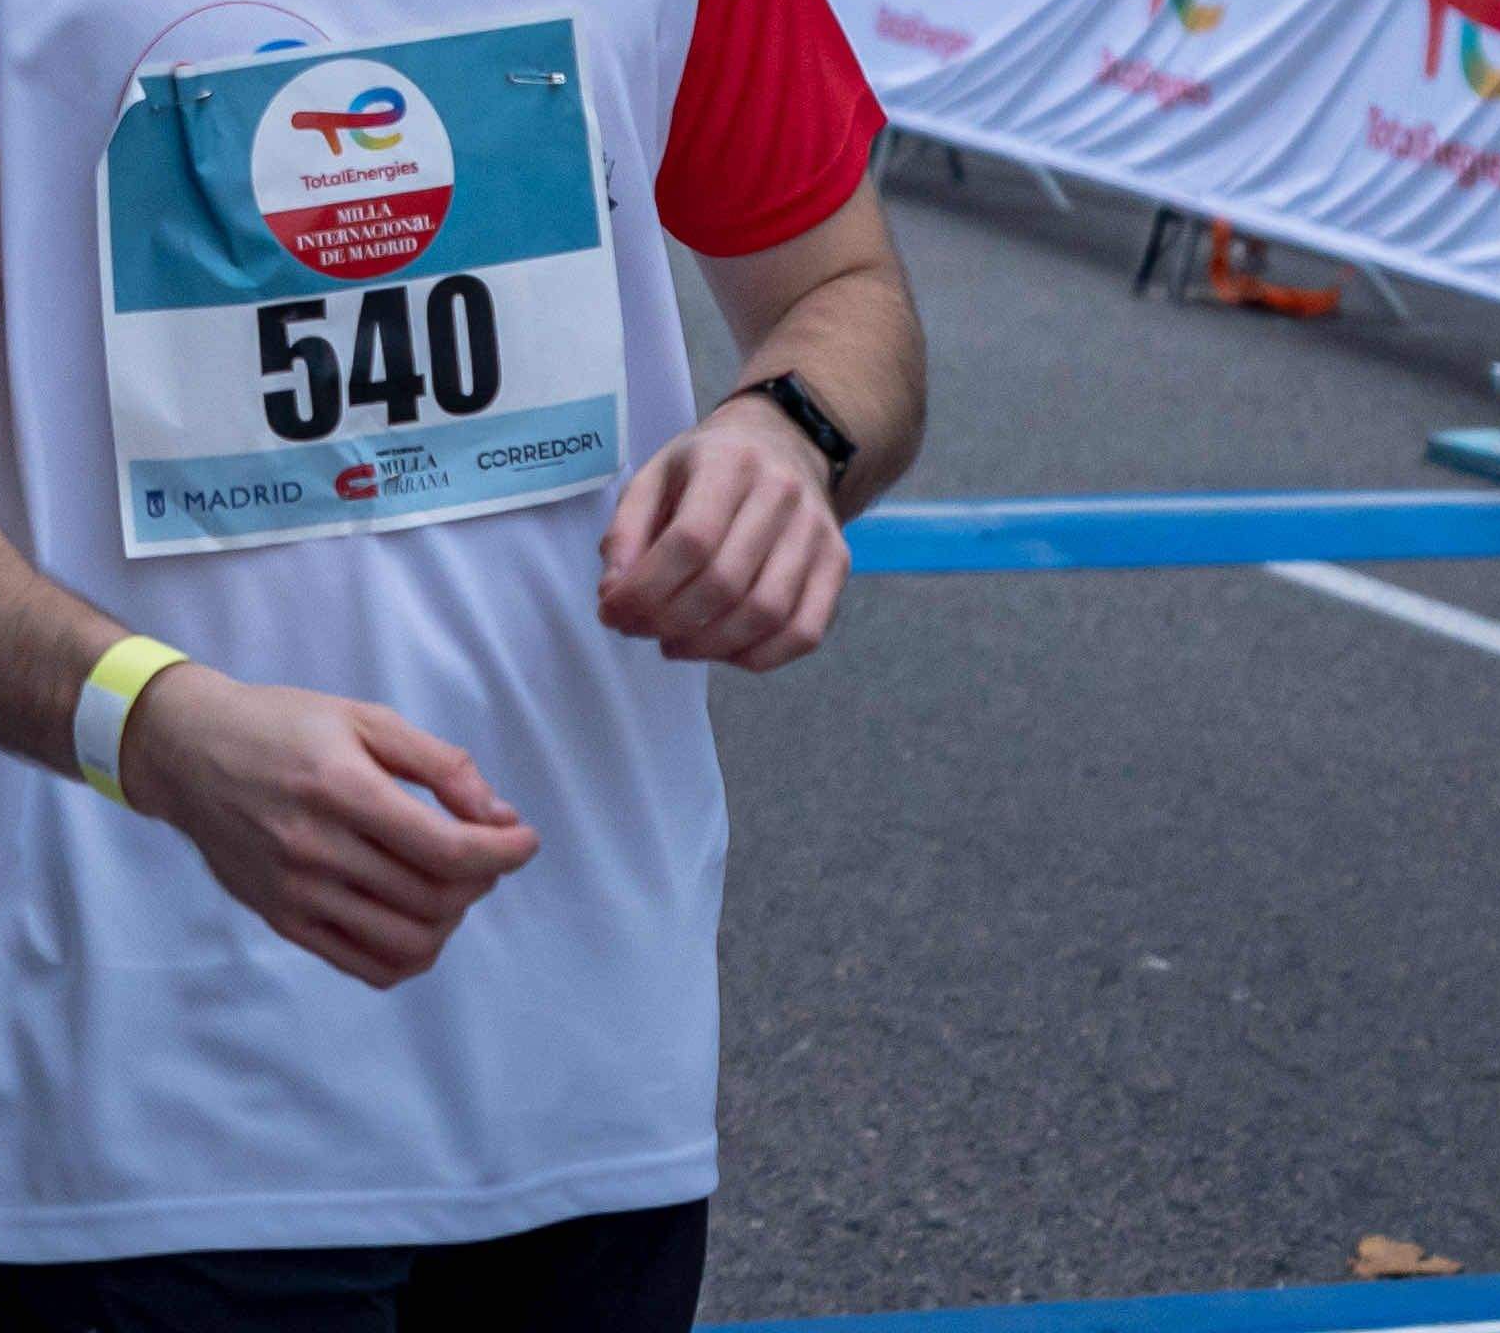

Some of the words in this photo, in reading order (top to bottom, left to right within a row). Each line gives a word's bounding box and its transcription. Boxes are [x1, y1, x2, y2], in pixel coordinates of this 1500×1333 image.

[300, 159, 419, 191] TotalEnergies
[336, 203, 394, 225] MILLA
[320, 245, 344, 266] DE
[348, 237, 418, 263] MADRID
[257, 273, 503, 443] 540
[377, 454, 438, 477] MILLA
[184, 481, 304, 511] MADRID
[382, 471, 451, 497] URBANA
